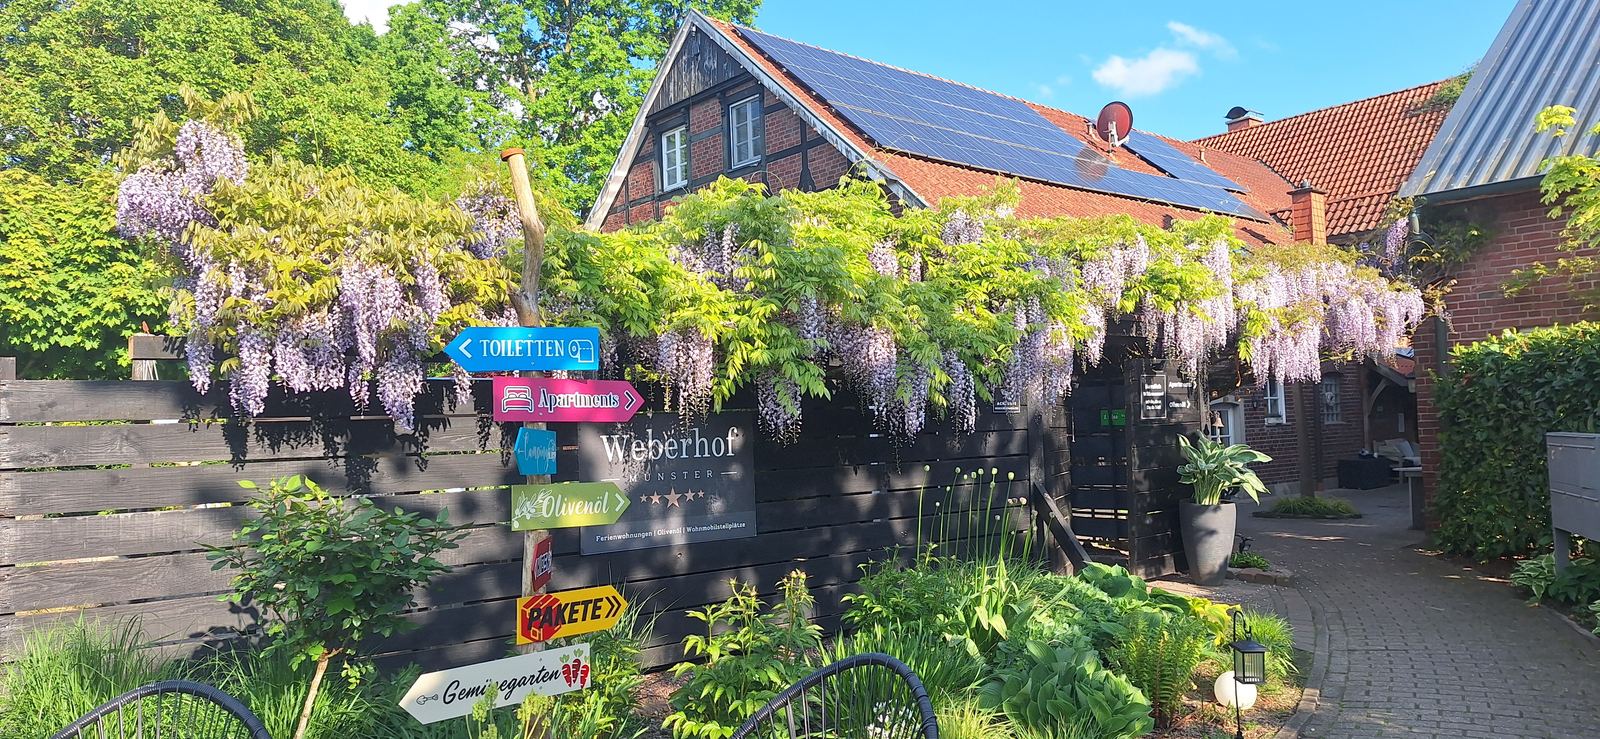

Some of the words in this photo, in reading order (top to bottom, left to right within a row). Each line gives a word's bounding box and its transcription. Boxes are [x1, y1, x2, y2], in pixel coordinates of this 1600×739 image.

[479, 339, 565, 357] TOILETTEN
[537, 388, 620, 413] Apartments
[600, 426, 738, 463] Weberhof
[541, 491, 610, 518] Olivenöl
[596, 531, 653, 542] Ferienwohnungen
[657, 528, 682, 537] Olivenöl
[686, 523, 746, 533] Wohnmobilstellplätze
[527, 597, 604, 631] PAKETE
[443, 665, 562, 705] Gemüegarten
